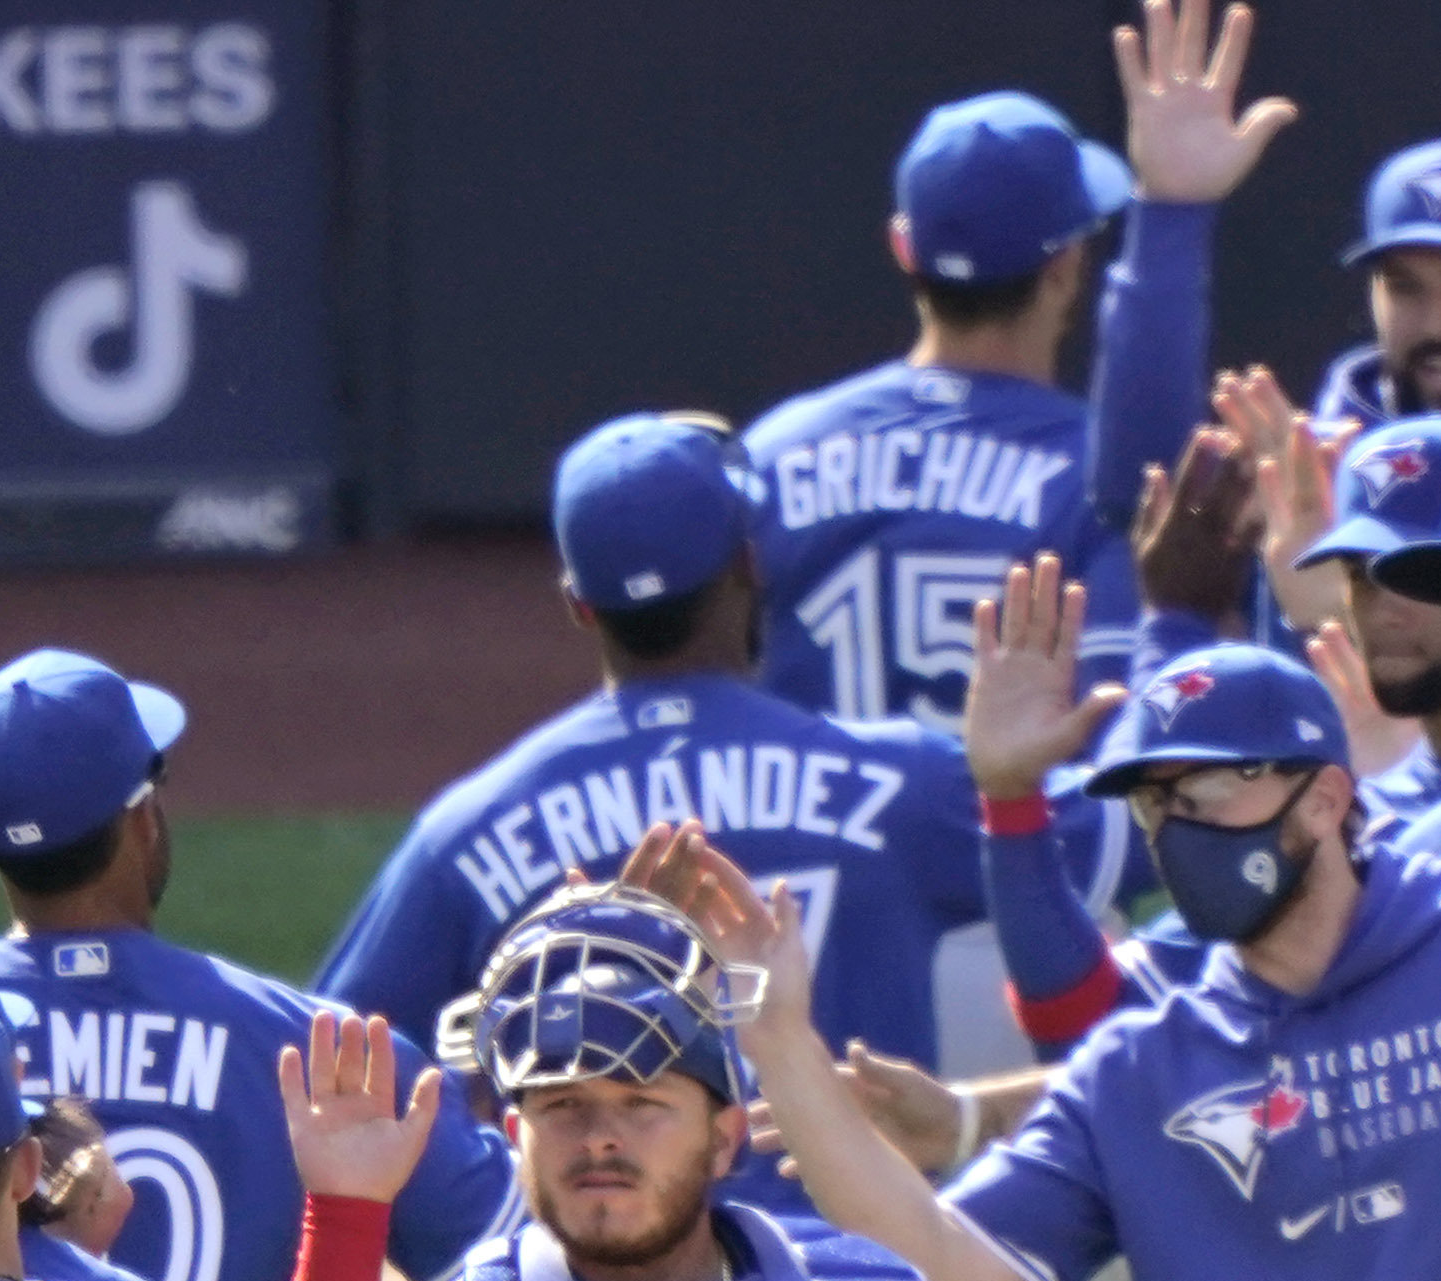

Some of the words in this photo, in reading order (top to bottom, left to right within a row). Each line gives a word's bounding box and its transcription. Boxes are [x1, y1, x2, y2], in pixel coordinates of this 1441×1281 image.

[775, 428, 1073, 530] GRICHUK
[1241, 849, 1278, 895] 9
[1311, 1074, 1391, 1119] BUE
